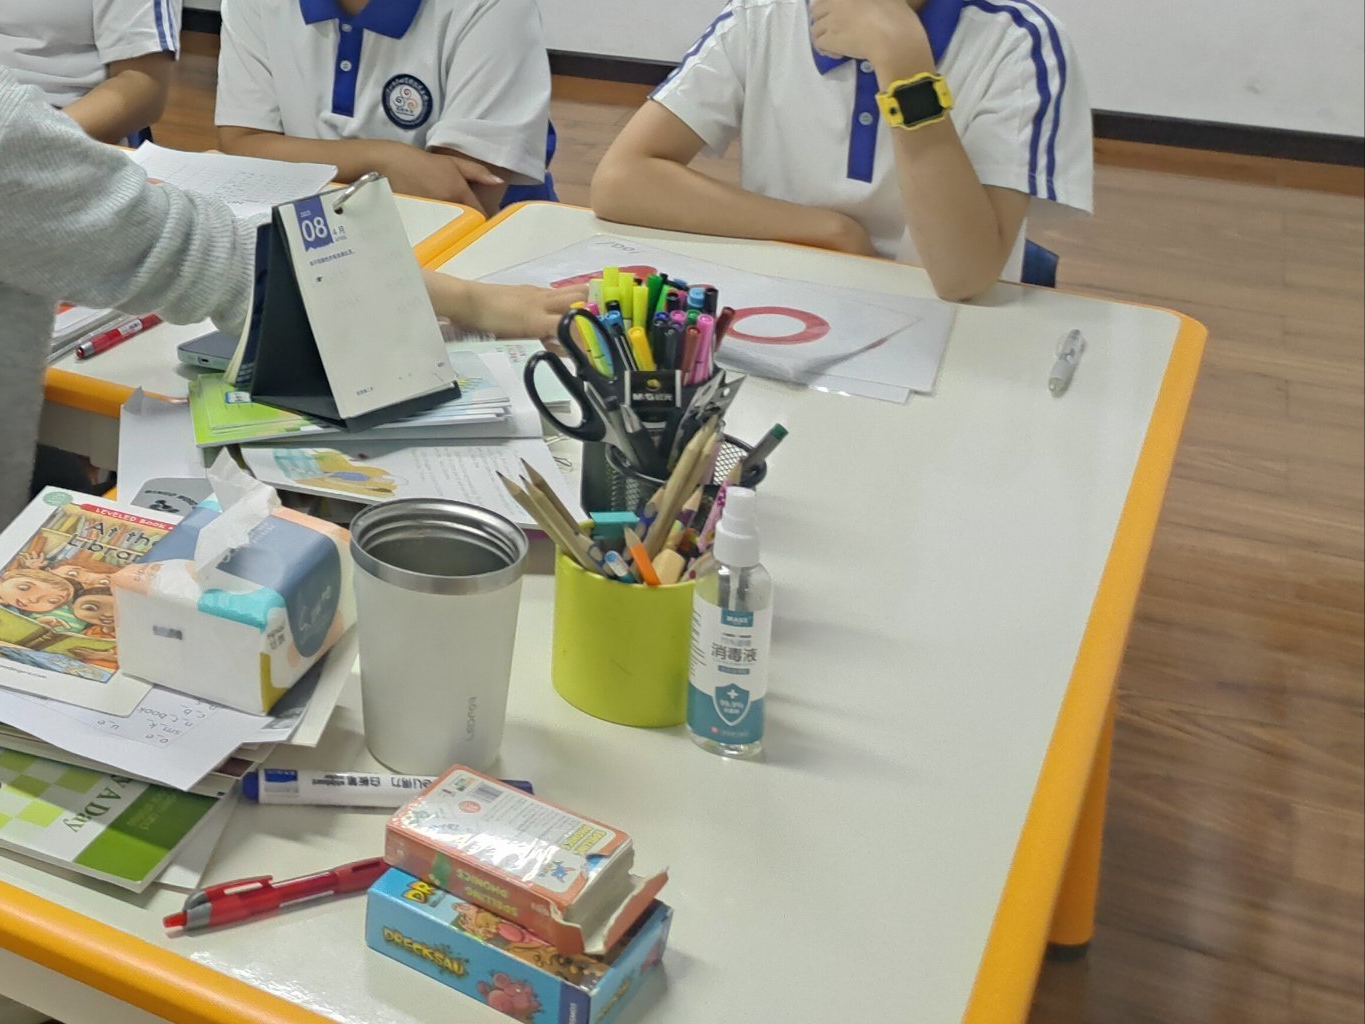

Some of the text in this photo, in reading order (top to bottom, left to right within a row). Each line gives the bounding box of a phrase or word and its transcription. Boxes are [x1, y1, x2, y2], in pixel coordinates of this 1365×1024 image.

[301, 216, 329, 242] 08
[95, 507, 137, 523] LEVELED
[85, 522, 157, 548] At th
[711, 642, 758, 663] 消毒液
[62, 802, 111, 832] Day
[382, 925, 465, 977] DRECKSAU
